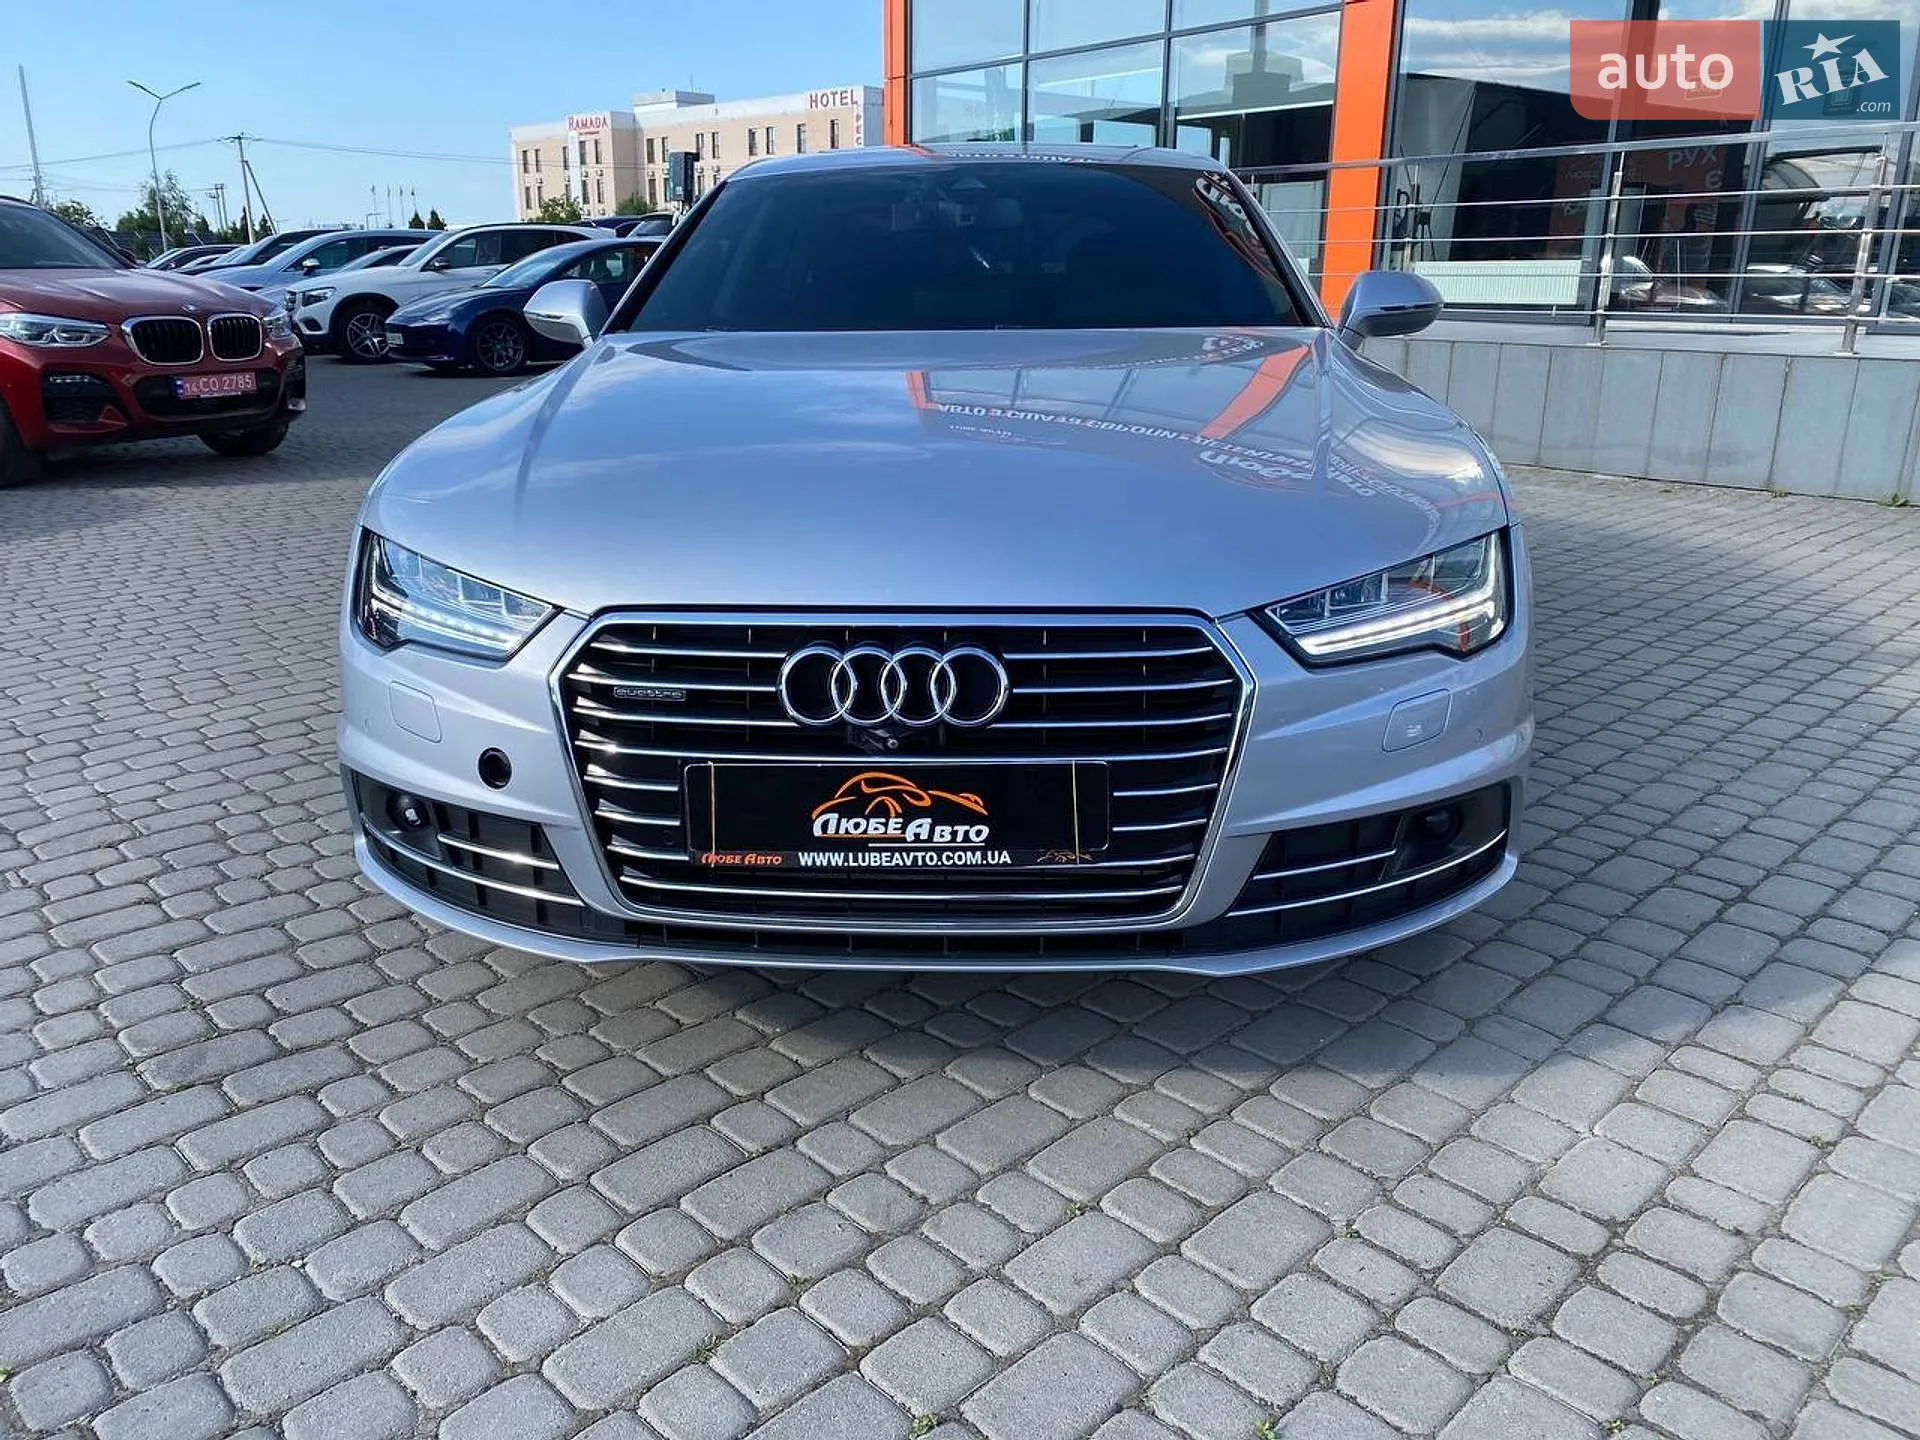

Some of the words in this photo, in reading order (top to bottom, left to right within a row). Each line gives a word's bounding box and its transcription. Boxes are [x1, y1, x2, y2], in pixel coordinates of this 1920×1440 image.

[809, 88, 858, 109] HOTEL
[567, 115, 609, 131] RAMADA
[799, 850, 1012, 867] WWW.LUBEAVTO.COM.UA
